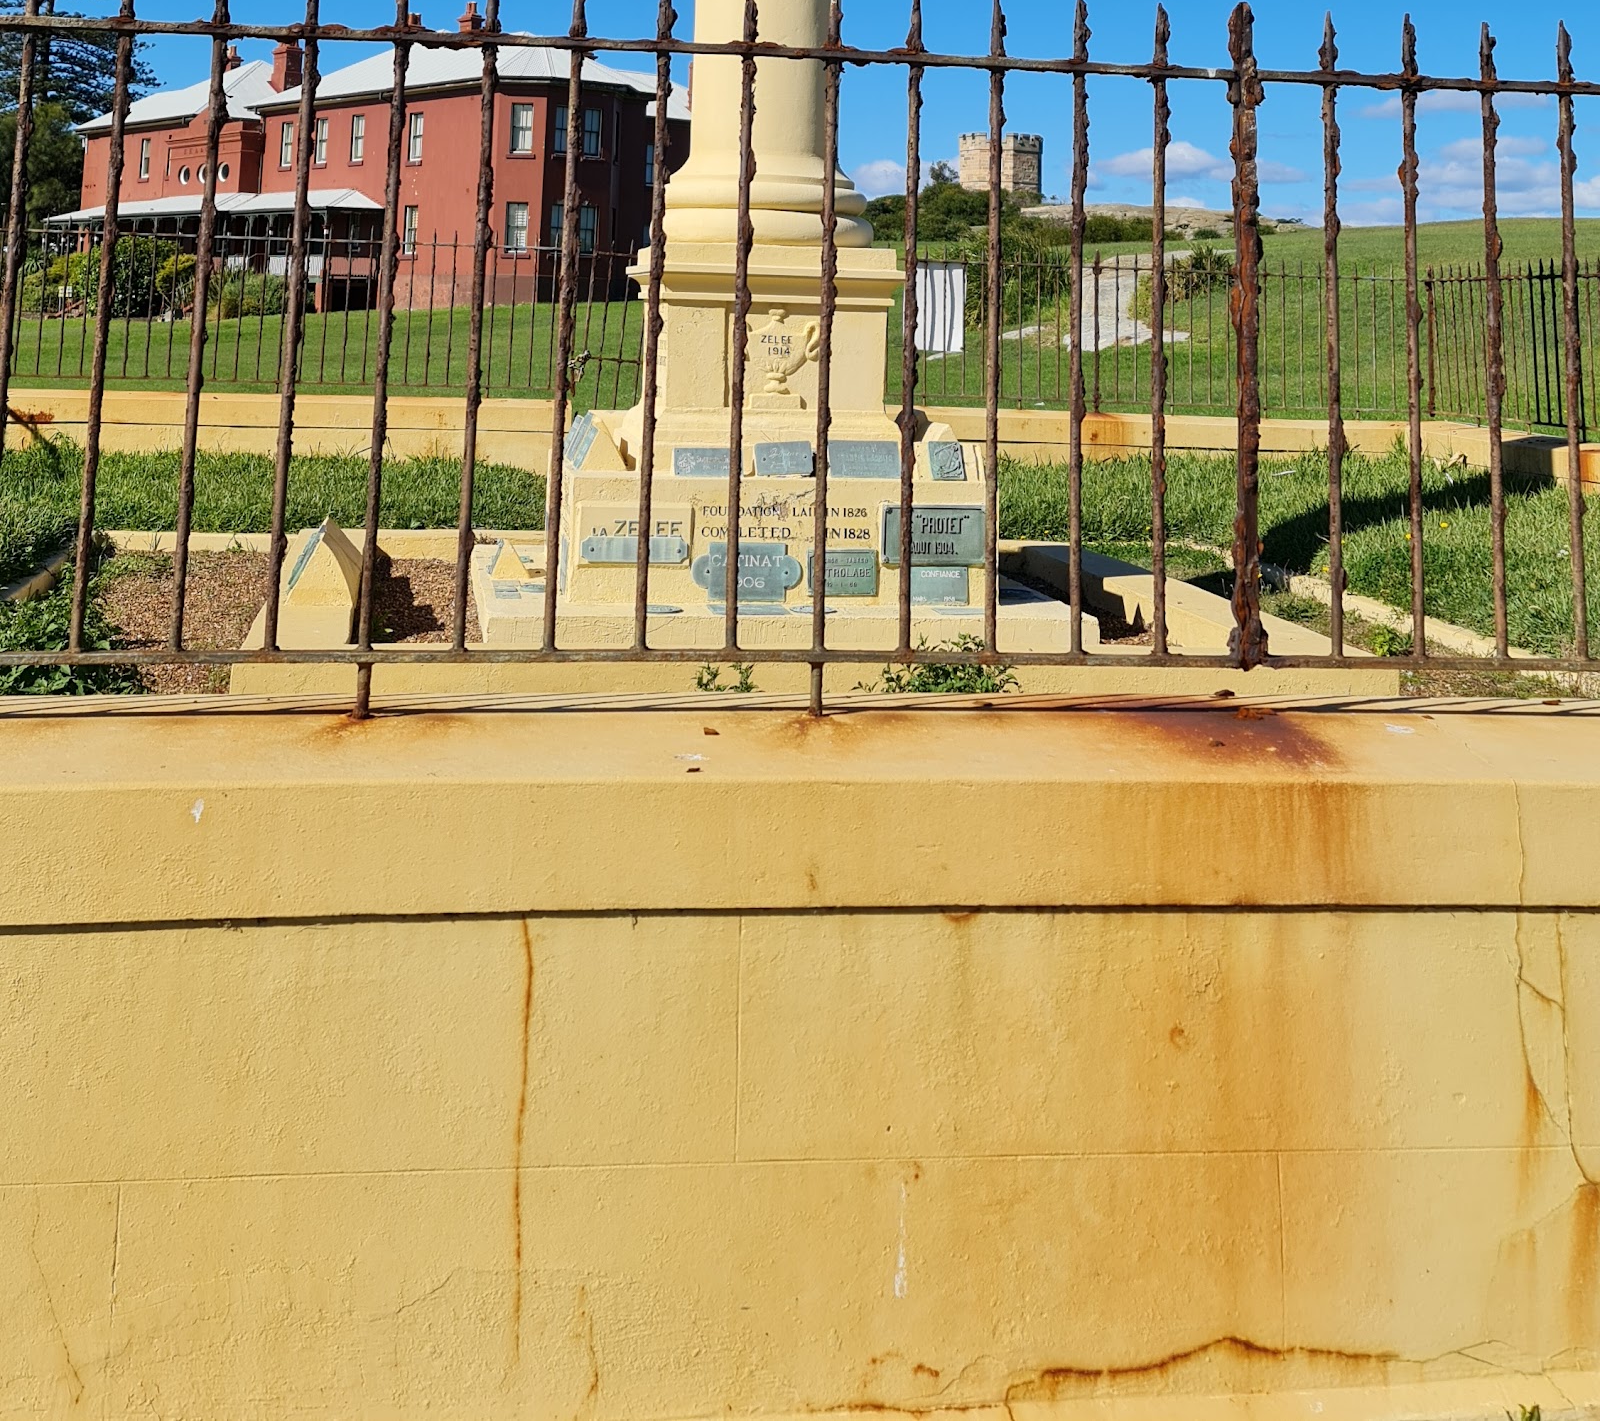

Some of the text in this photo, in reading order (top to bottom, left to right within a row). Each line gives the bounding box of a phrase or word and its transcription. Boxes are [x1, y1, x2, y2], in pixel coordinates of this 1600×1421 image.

[760, 335, 793, 344] ZELEE
[768, 347, 791, 355] 1914
[702, 505, 782, 517] FOUDATION
[792, 507, 819, 517] LAI
[843, 507, 868, 518] 1826
[592, 520, 683, 537] LA ZEEE
[701, 526, 791, 539] COMLETED
[843, 528, 871, 540] 1828
[812, 568, 872, 578] TROLABE
[920, 570, 961, 579] CONFIANCE
